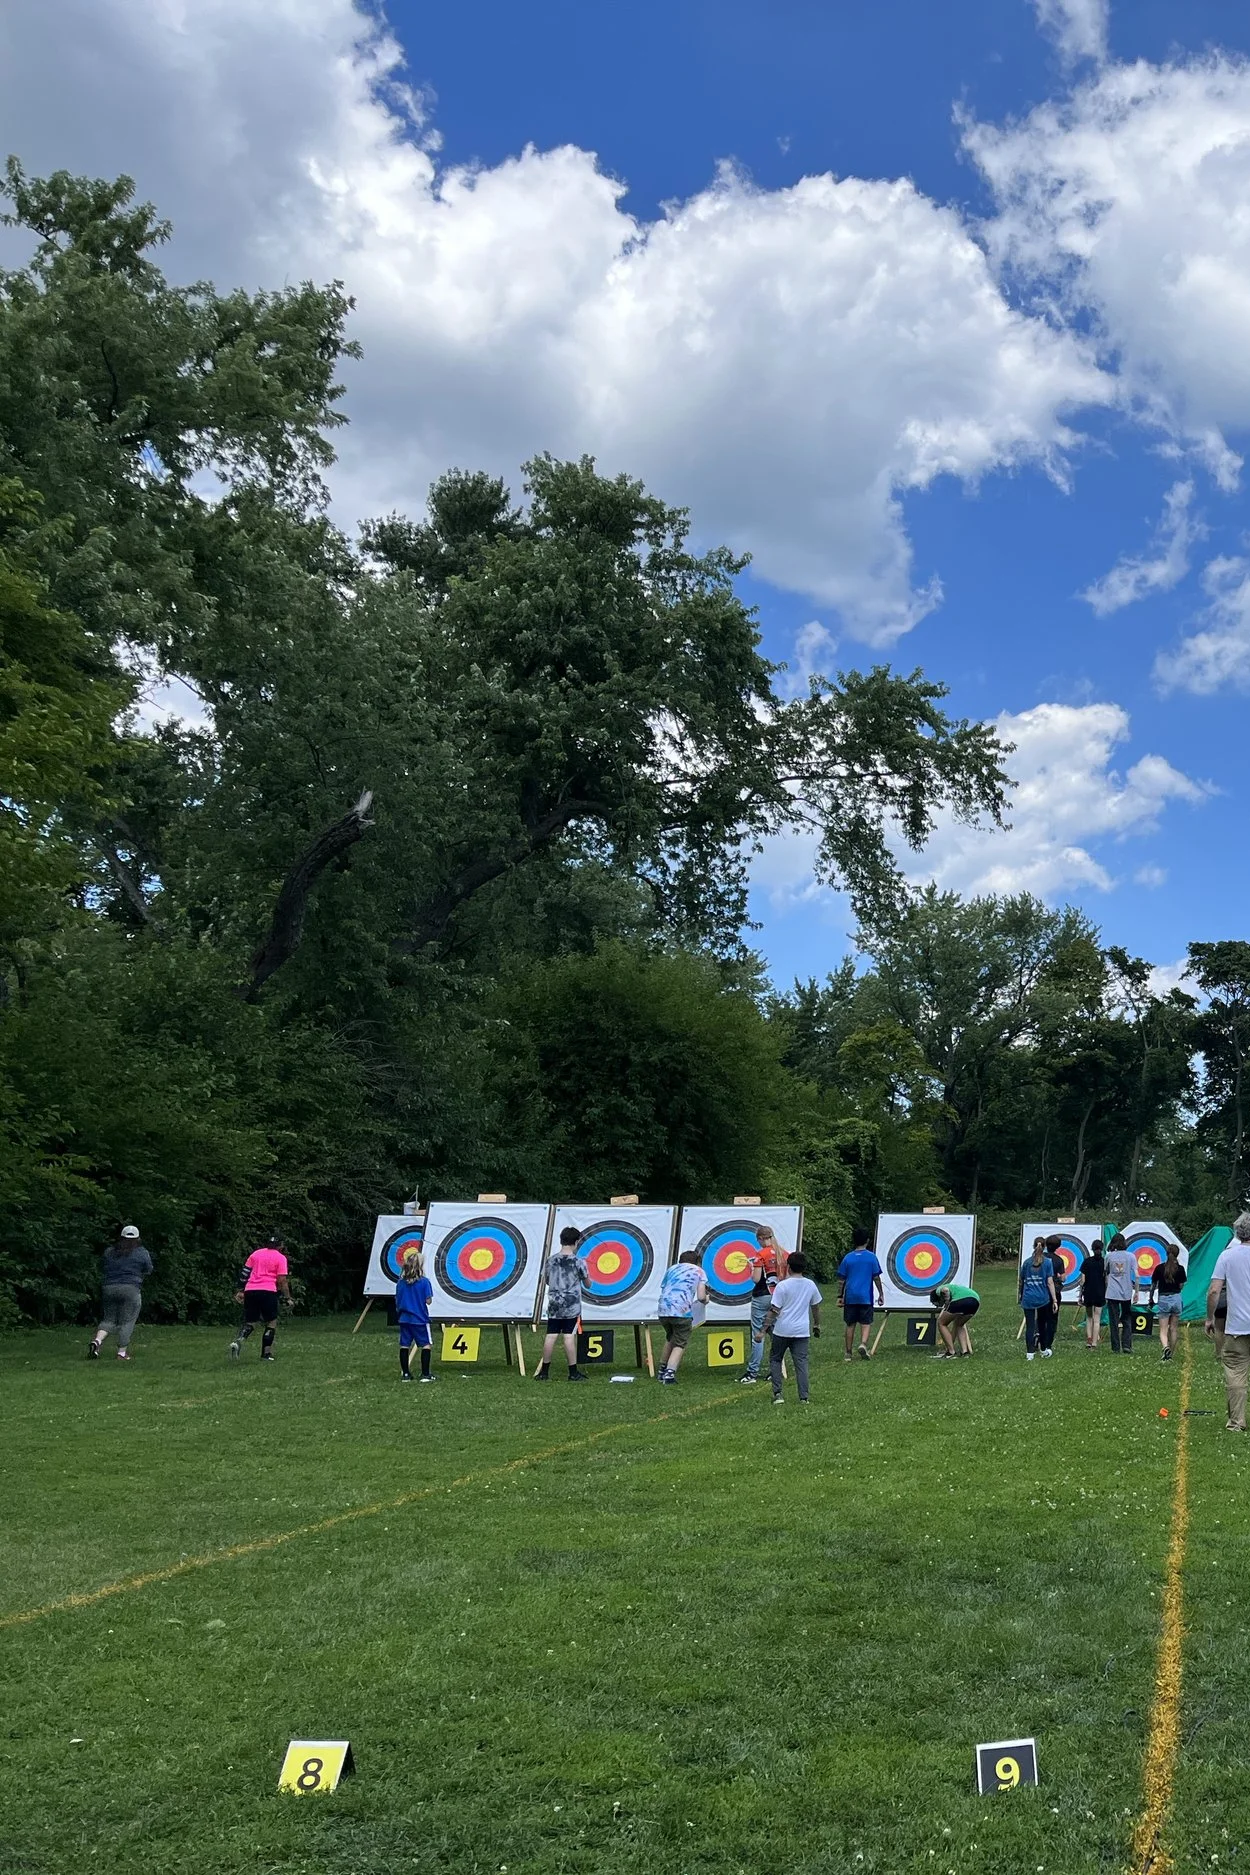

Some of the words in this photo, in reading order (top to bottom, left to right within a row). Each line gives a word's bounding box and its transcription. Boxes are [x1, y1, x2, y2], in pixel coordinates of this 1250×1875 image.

[915, 1322, 929, 1340] 7
[1135, 1315, 1147, 1331] 9
[451, 1333, 468, 1355] 4
[587, 1336, 603, 1358] 5
[718, 1338, 734, 1359] 6
[296, 1757, 324, 1791] 8
[995, 1756, 1020, 1792] 9
